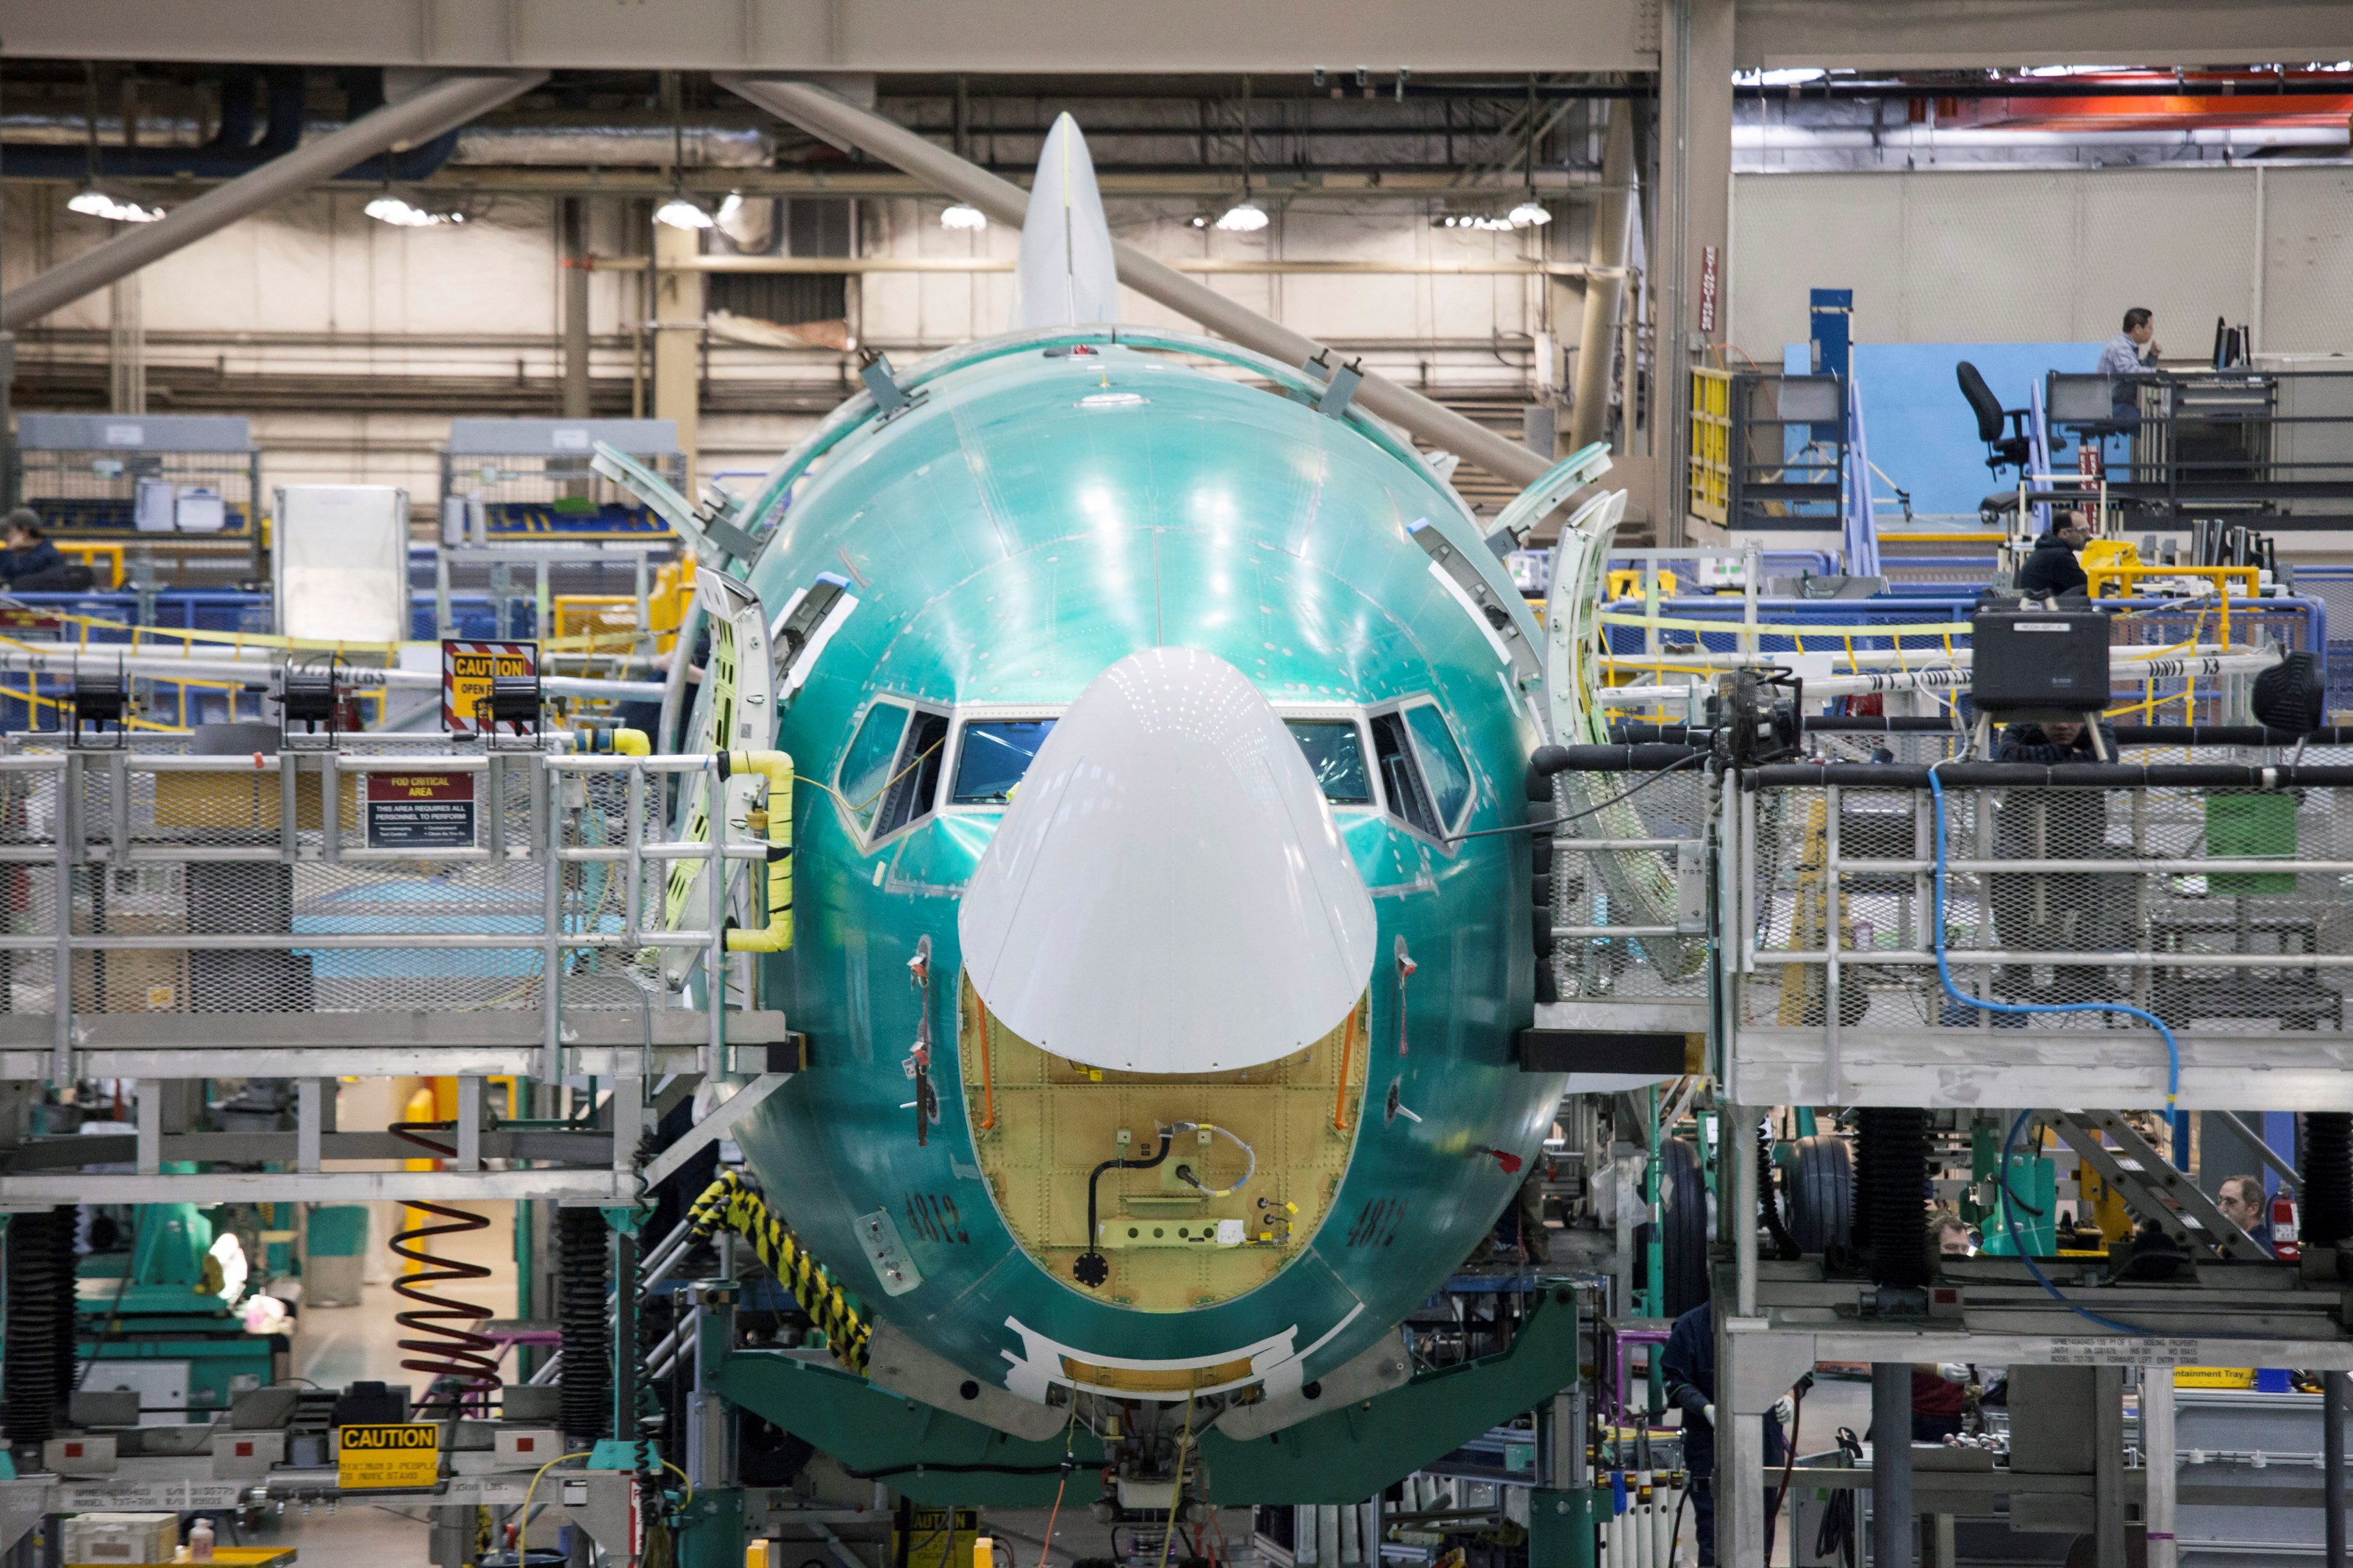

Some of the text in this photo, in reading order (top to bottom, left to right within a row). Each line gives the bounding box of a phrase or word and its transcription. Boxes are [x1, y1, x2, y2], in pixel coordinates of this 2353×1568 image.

[456, 658, 523, 676] CAUTION
[390, 776, 450, 786] FOD CRITICAL
[408, 787, 433, 796] AREA
[2224, 1370, 2243, 1378] Tray
[344, 1428, 434, 1447] CAUTION
